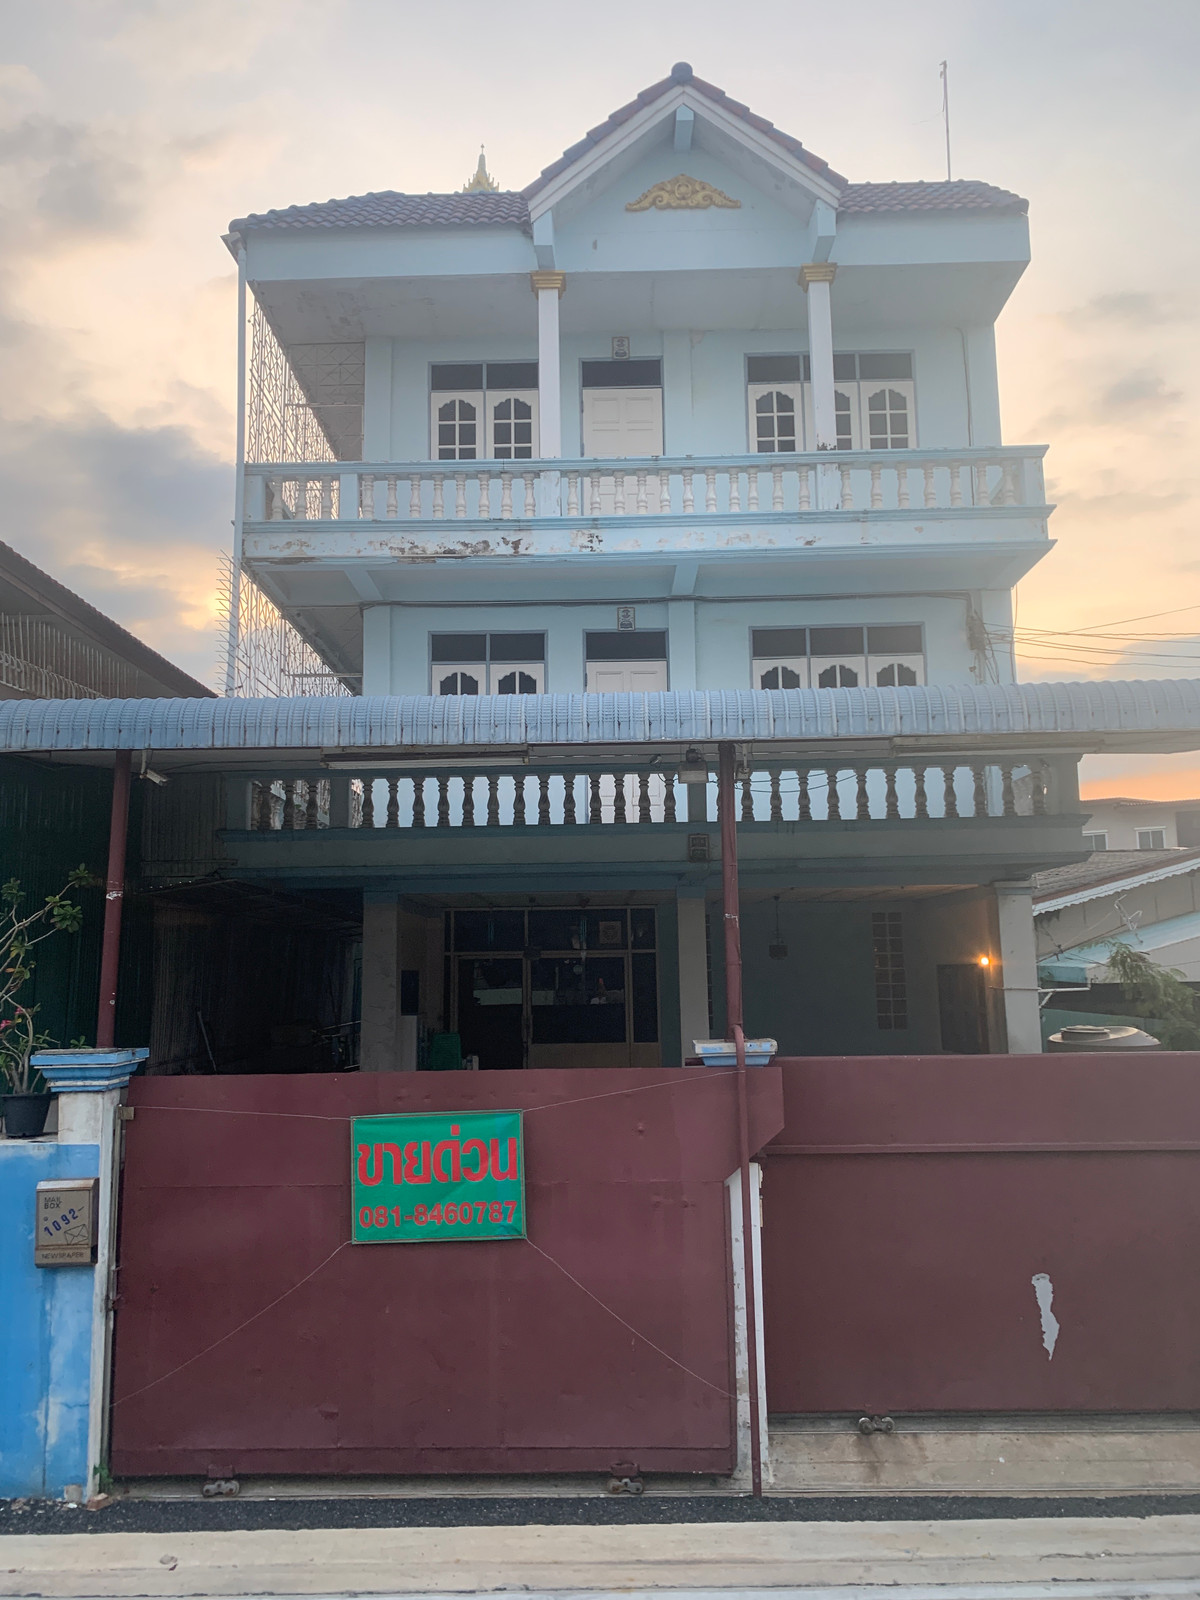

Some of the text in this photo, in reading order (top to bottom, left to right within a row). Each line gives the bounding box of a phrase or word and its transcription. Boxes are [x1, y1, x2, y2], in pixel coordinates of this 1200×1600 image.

[357, 1125, 518, 1186] ขายด่วน
[43, 1208, 79, 1237] 1092
[359, 1201, 518, 1229] 081-8460787
[41, 1251, 84, 1260] NEWSPAPER
